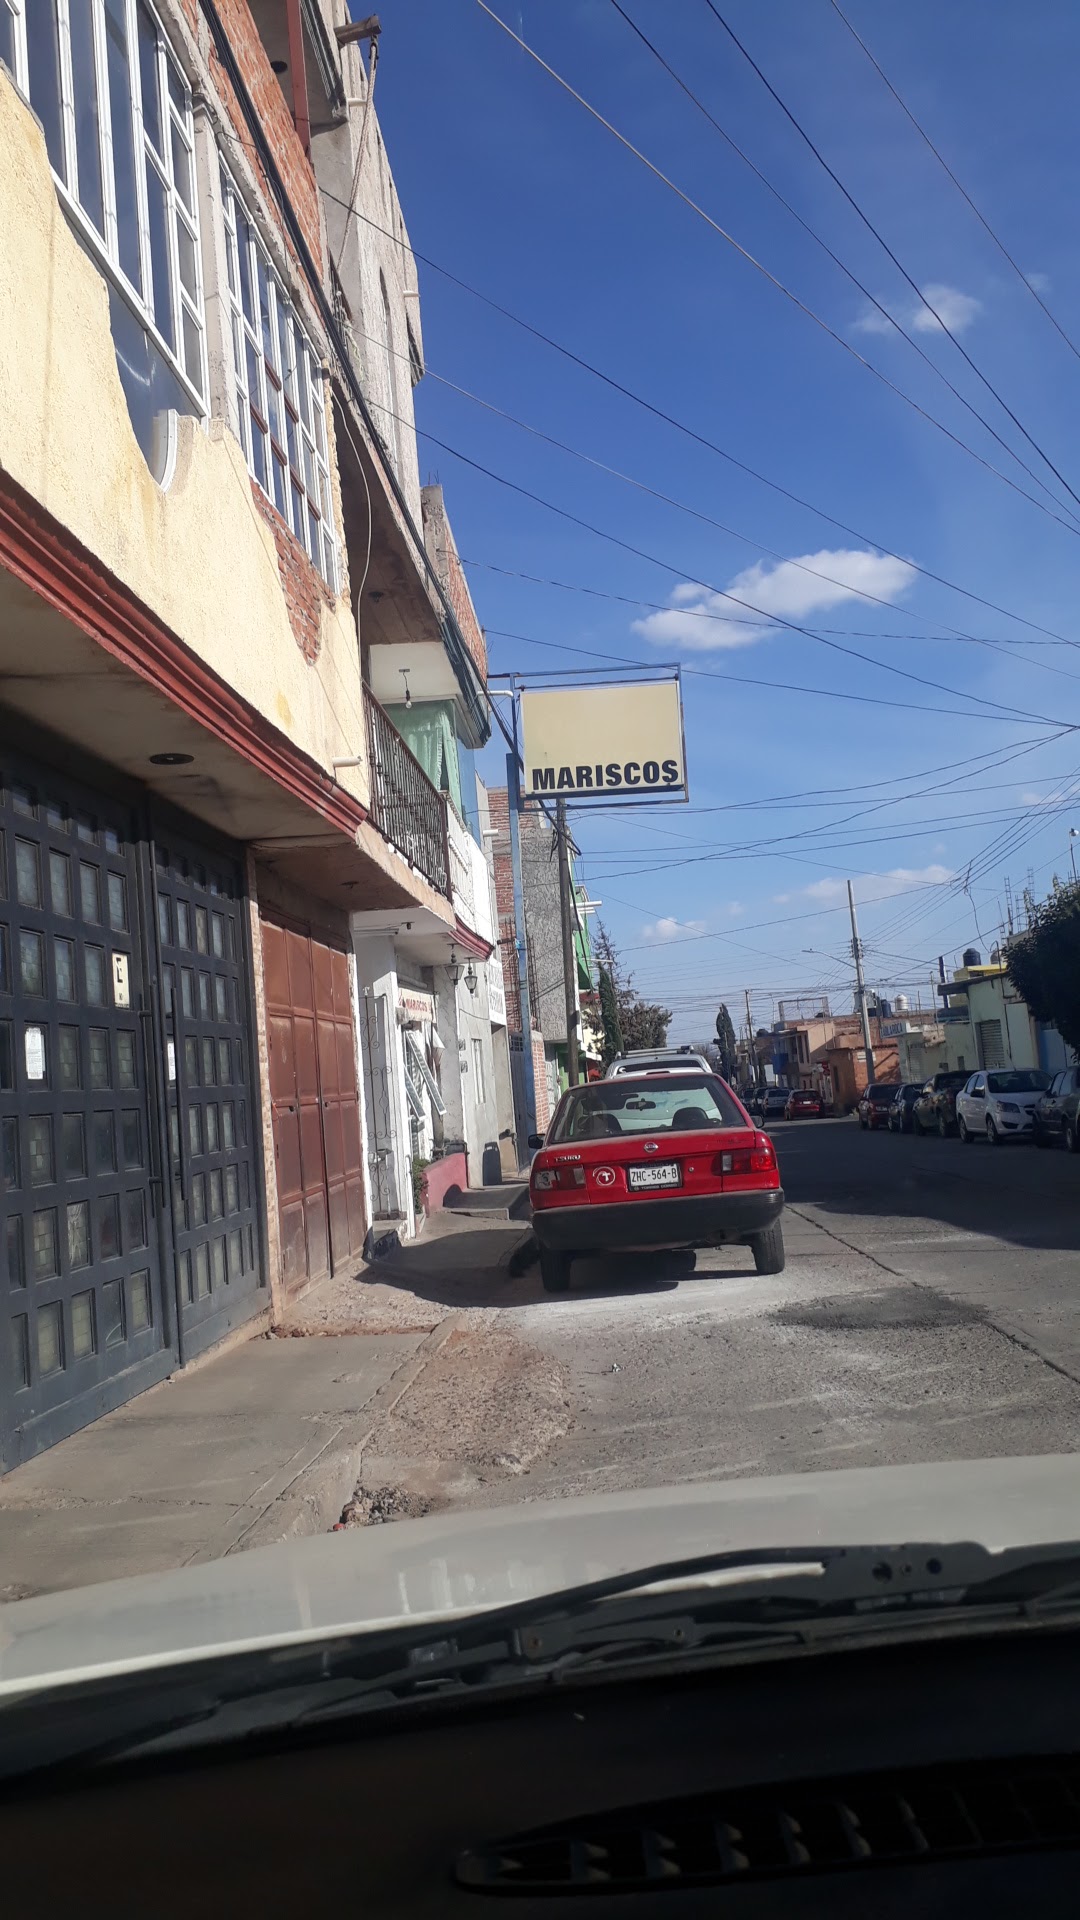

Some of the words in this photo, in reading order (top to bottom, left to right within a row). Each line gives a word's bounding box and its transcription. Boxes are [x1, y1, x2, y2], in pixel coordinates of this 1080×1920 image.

[532, 760, 679, 790] MARISCOS
[554, 1154, 581, 1162] TSURU
[631, 1168, 677, 1182] ZHC-564-B
